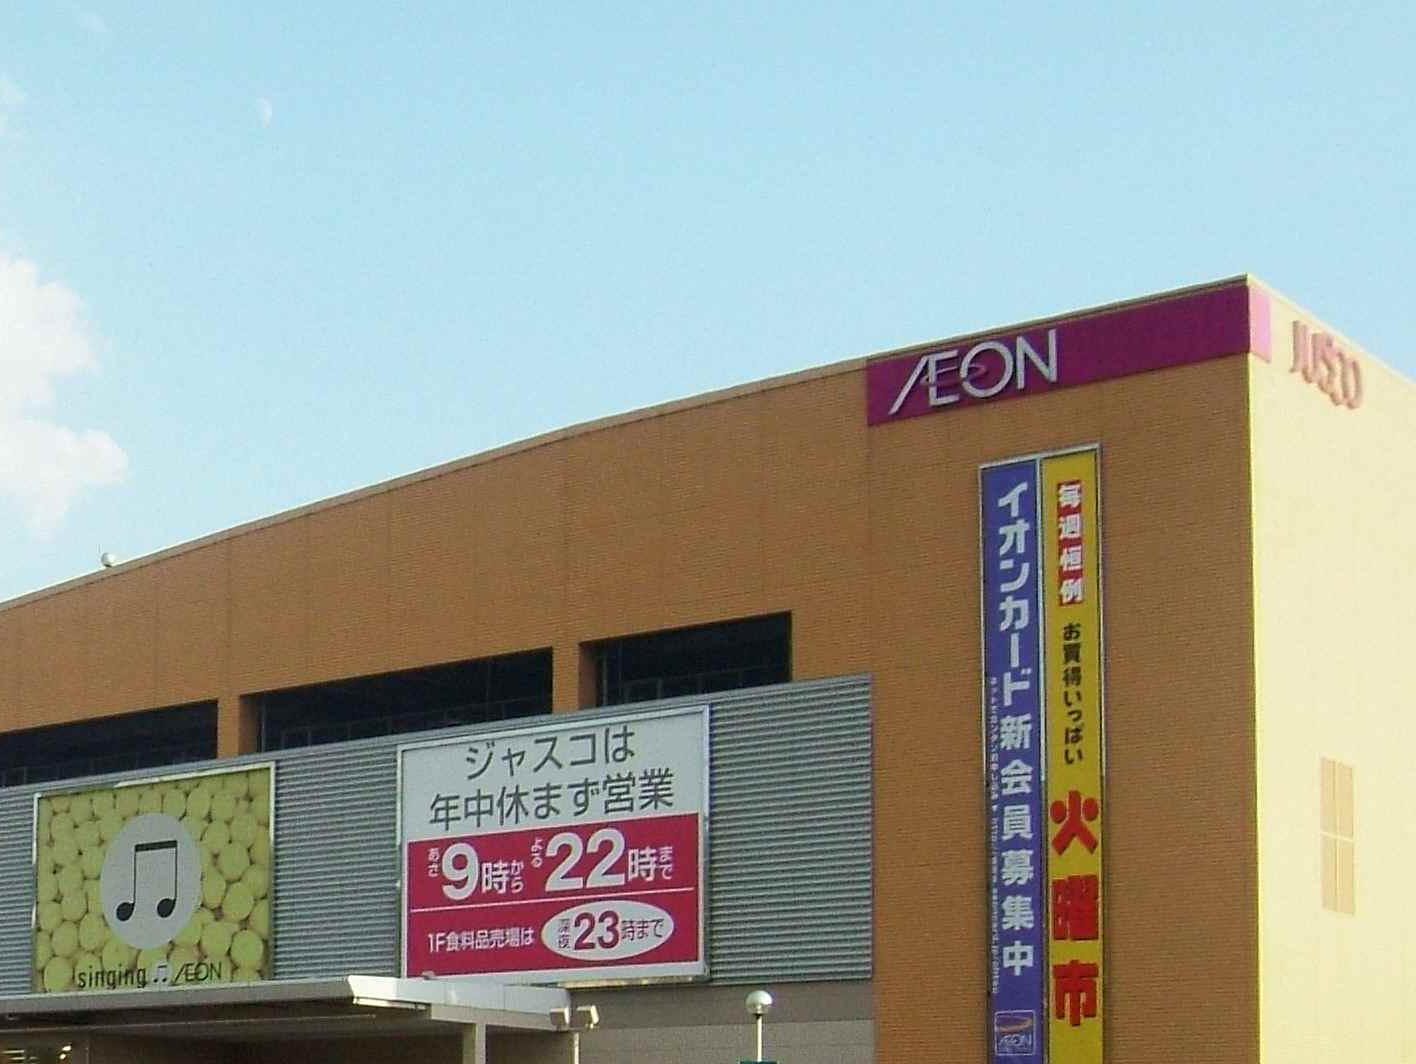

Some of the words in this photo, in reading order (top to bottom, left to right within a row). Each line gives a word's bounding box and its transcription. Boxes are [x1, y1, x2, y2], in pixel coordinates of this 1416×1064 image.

[997, 481, 1035, 977] イオンカード新会員募集中
[1061, 622, 1083, 765] お買得いっぱい
[429, 767, 675, 831] 年中休まず営業
[465, 725, 636, 780] ジャスコは
[1049, 789, 1100, 1027] 火曜市
[77, 965, 147, 988] singing
